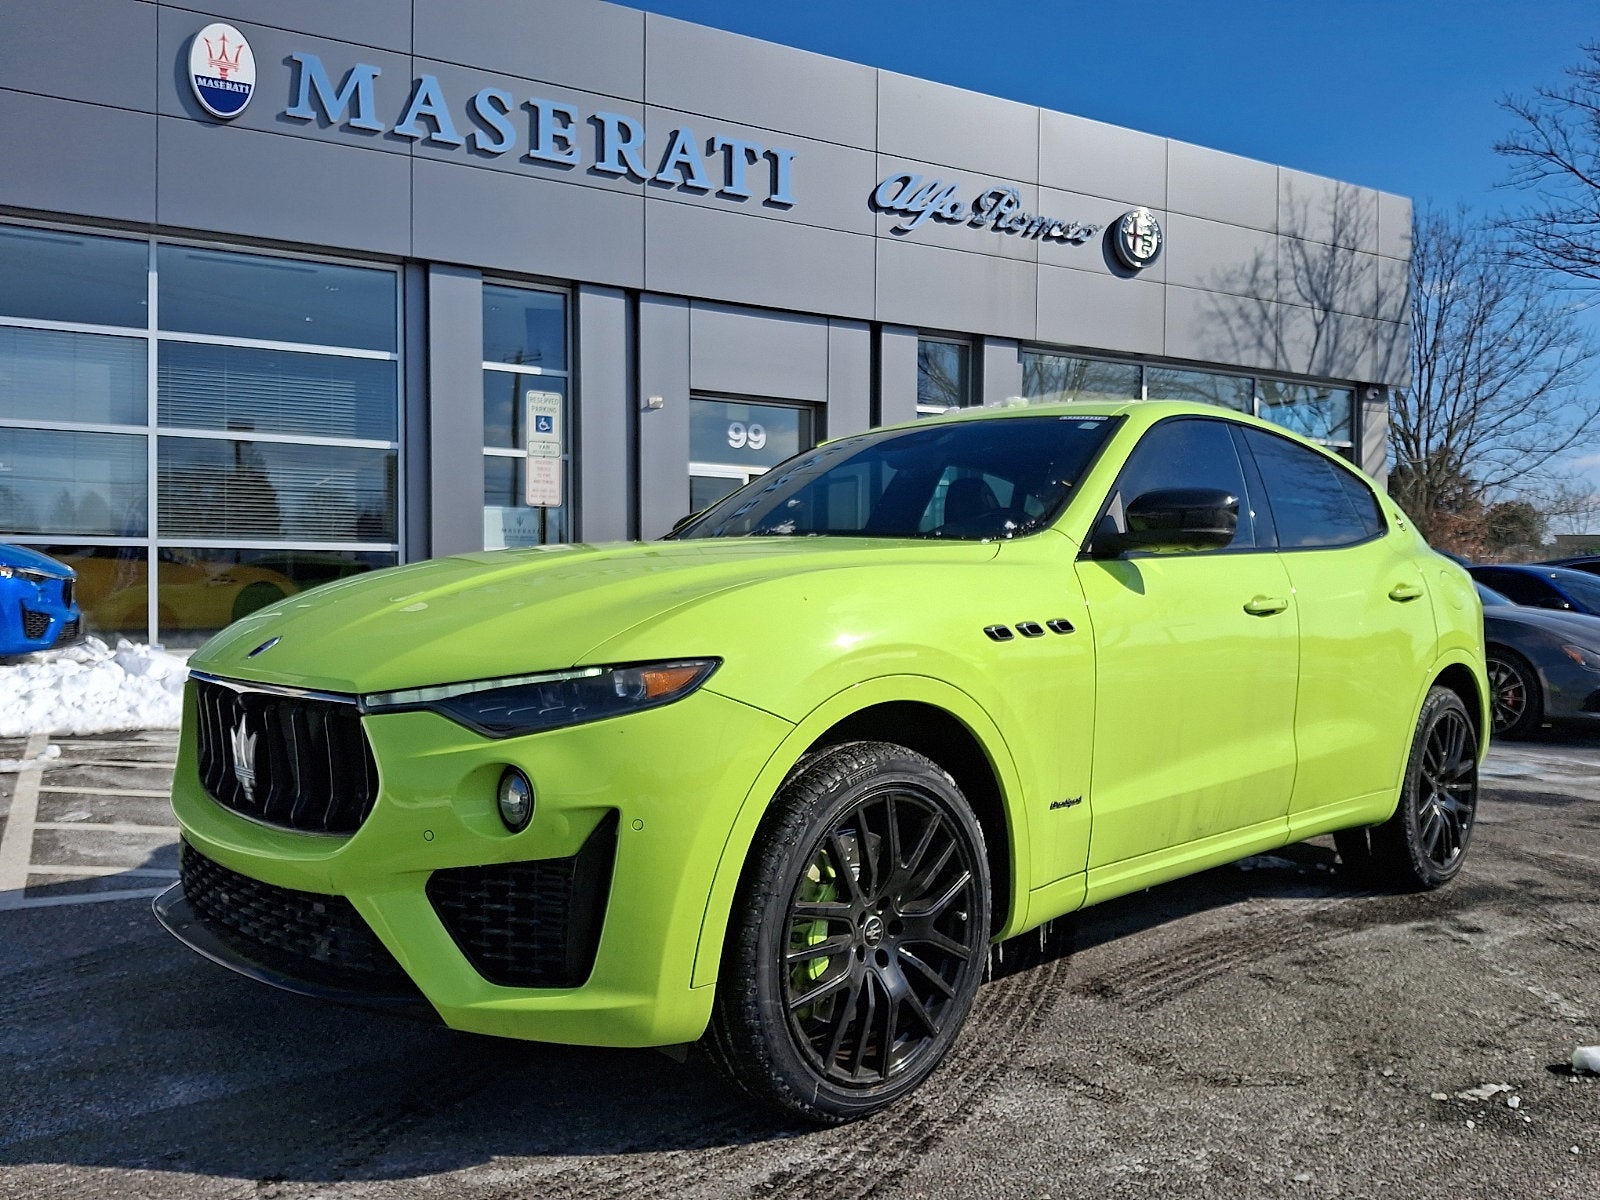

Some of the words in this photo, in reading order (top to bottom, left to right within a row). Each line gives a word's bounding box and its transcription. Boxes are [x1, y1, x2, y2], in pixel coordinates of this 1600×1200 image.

[197, 76, 250, 94] MASERATI
[284, 51, 798, 206] MASERATI
[871, 172, 965, 234] Alfa
[972, 185, 1101, 244] Romeo
[529, 396, 559, 406] RESERVED
[531, 406, 557, 414] PARKING
[728, 422, 767, 450] 99
